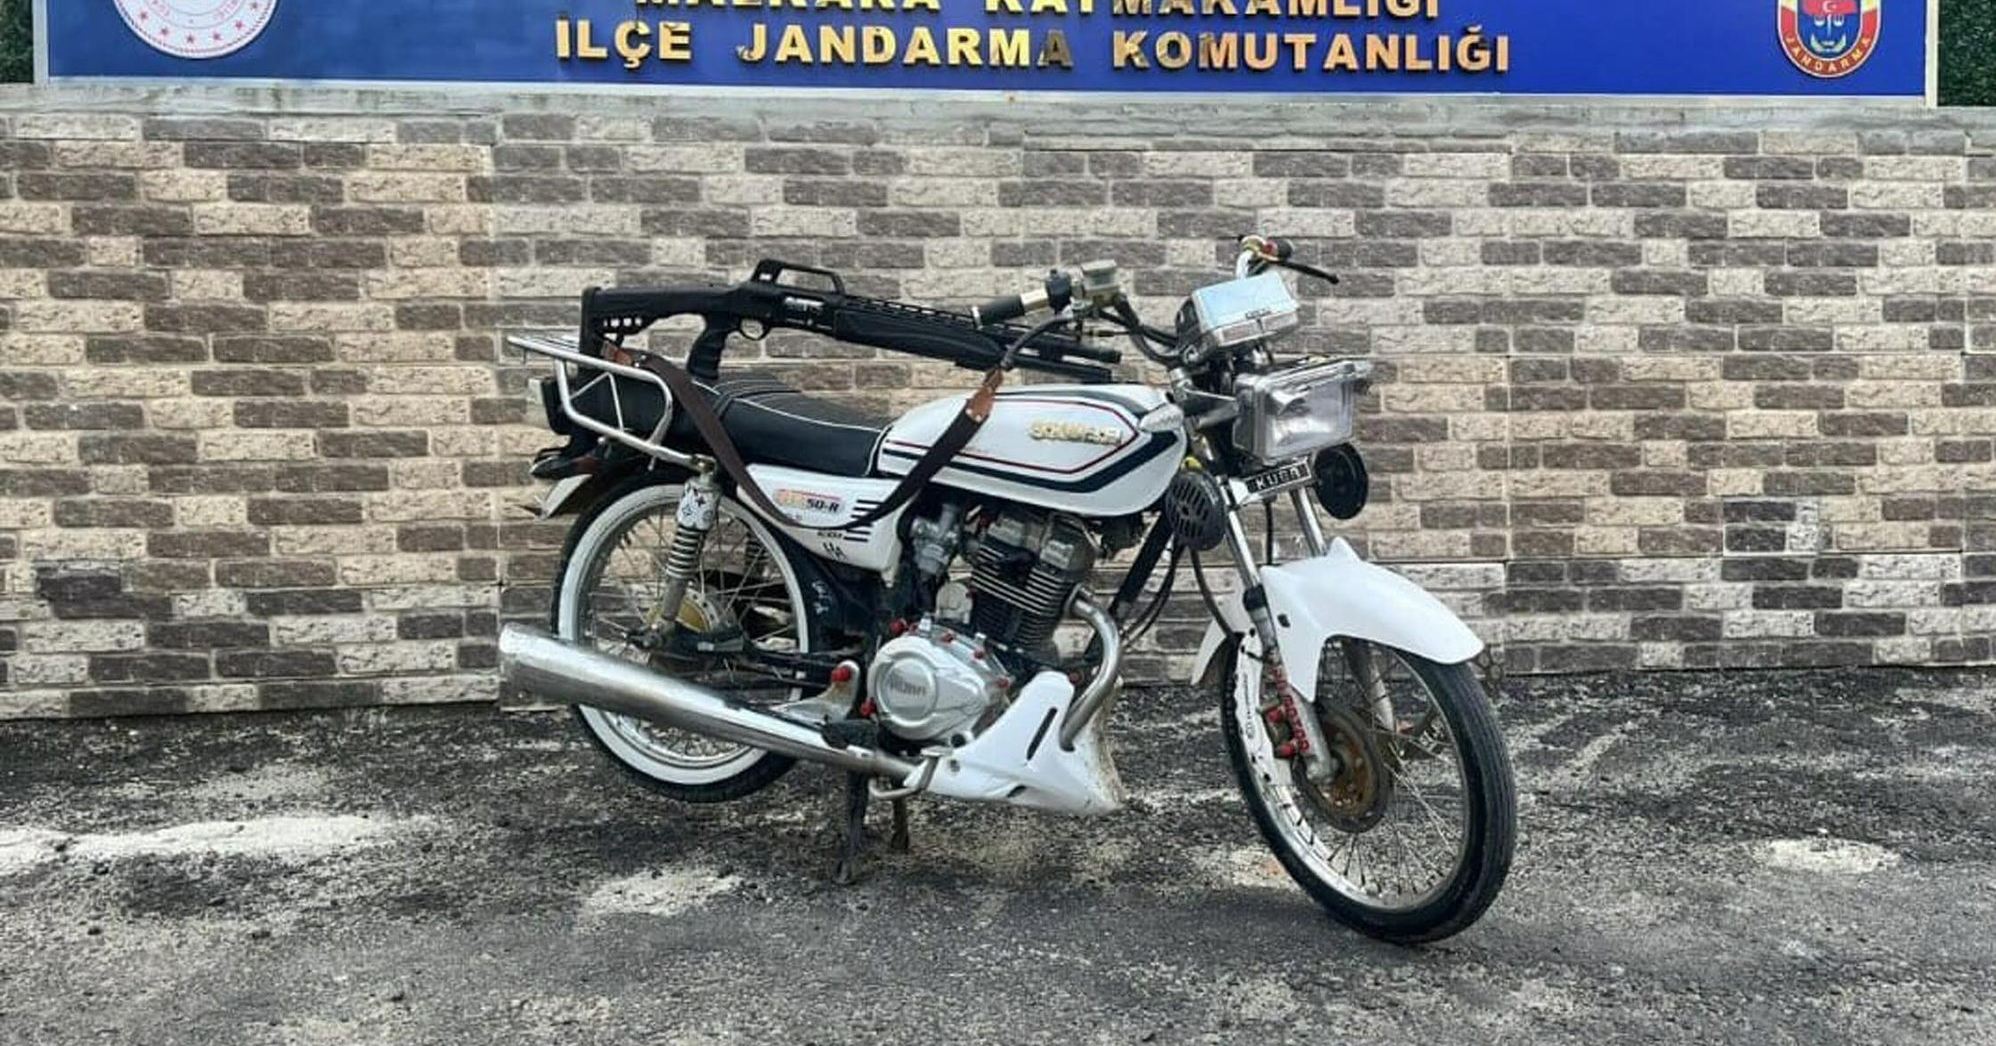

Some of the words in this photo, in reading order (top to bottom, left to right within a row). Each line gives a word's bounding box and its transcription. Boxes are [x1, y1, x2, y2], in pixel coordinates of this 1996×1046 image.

[555, 16, 692, 69] İLÇE
[736, 23, 1074, 67] JANDARMA
[1113, 25, 1509, 71] KOMUTANLIĞI
[1785, 35, 1871, 72] JANDARMA
